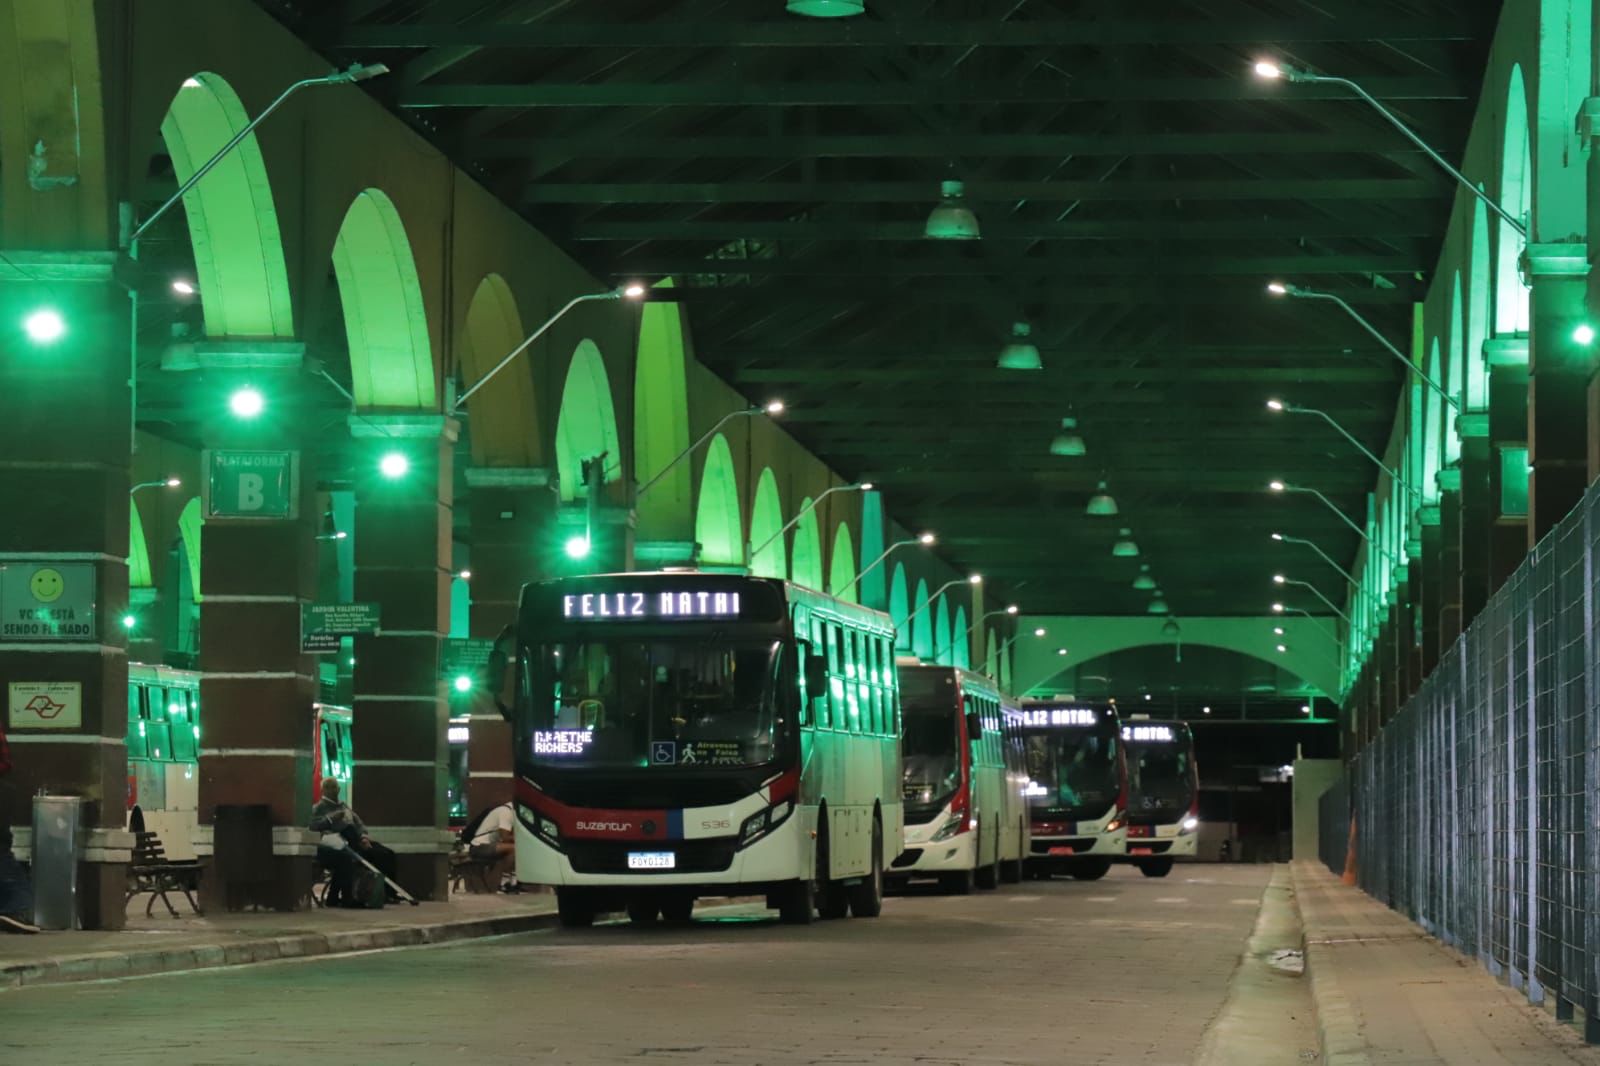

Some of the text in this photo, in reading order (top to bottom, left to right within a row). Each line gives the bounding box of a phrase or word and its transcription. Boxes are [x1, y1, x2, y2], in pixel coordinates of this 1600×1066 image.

[216, 455, 286, 466] PLATAFORMA
[238, 472, 264, 511] B
[563, 592, 644, 616] FELIZ
[3, 624, 39, 635] SENDO
[701, 819, 731, 830] 536
